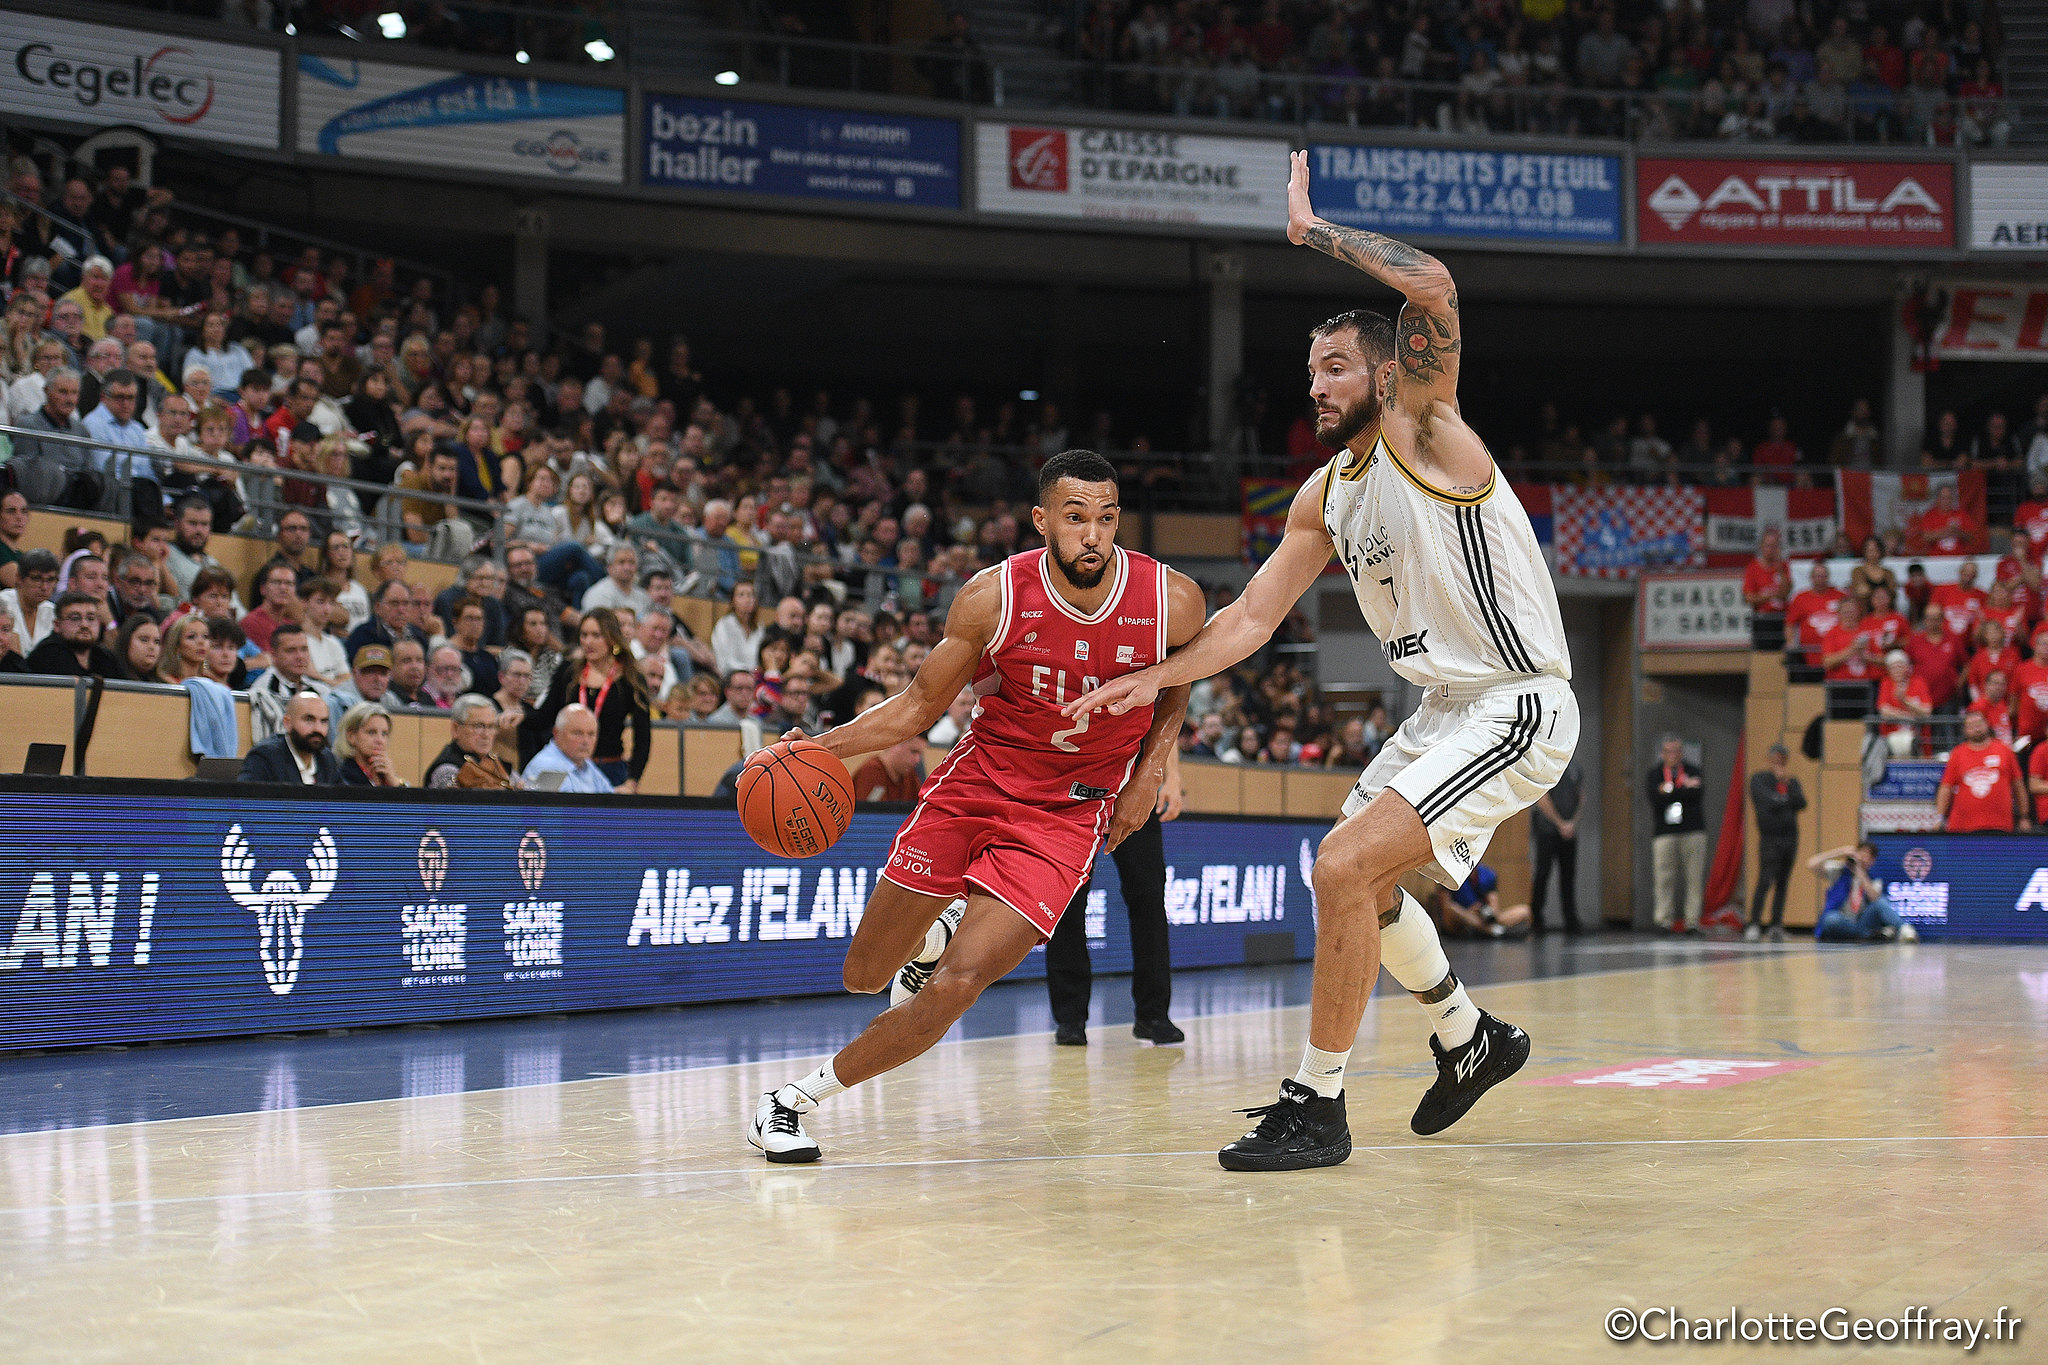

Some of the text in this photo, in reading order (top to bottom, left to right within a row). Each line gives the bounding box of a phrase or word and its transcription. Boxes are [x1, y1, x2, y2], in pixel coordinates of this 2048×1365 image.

[15, 43, 197, 104] Cegelec
[651, 103, 757, 146] bezin
[1080, 129, 1179, 157] CAISSE
[650, 143, 761, 184] haller
[1315, 147, 1612, 191] TRANSPORTS PETEUIL
[1355, 182, 1575, 217] 06.22.41.40.08
[1702, 175, 1942, 213] ATTILA
[1761, 214, 1778, 228] et
[1788, 525, 1826, 547] EST
[1379, 576, 1399, 609] 7
[1653, 585, 1747, 609] CHALO
[1127, 617, 1155, 626] PAPREC
[1032, 665, 1110, 713] ELA
[1050, 712, 1090, 752] 2
[902, 859, 932, 877] JOA
[905, 851, 934, 864] SANTENAY
[907, 845, 928, 857] CASINO
[402, 894, 468, 938] SAÔNE
[503, 892, 565, 935] SAÔNE
[626, 867, 868, 946] Allez l'ELAN
[411, 937, 467, 971] LOIRE
[512, 933, 564, 967] LOIRE
